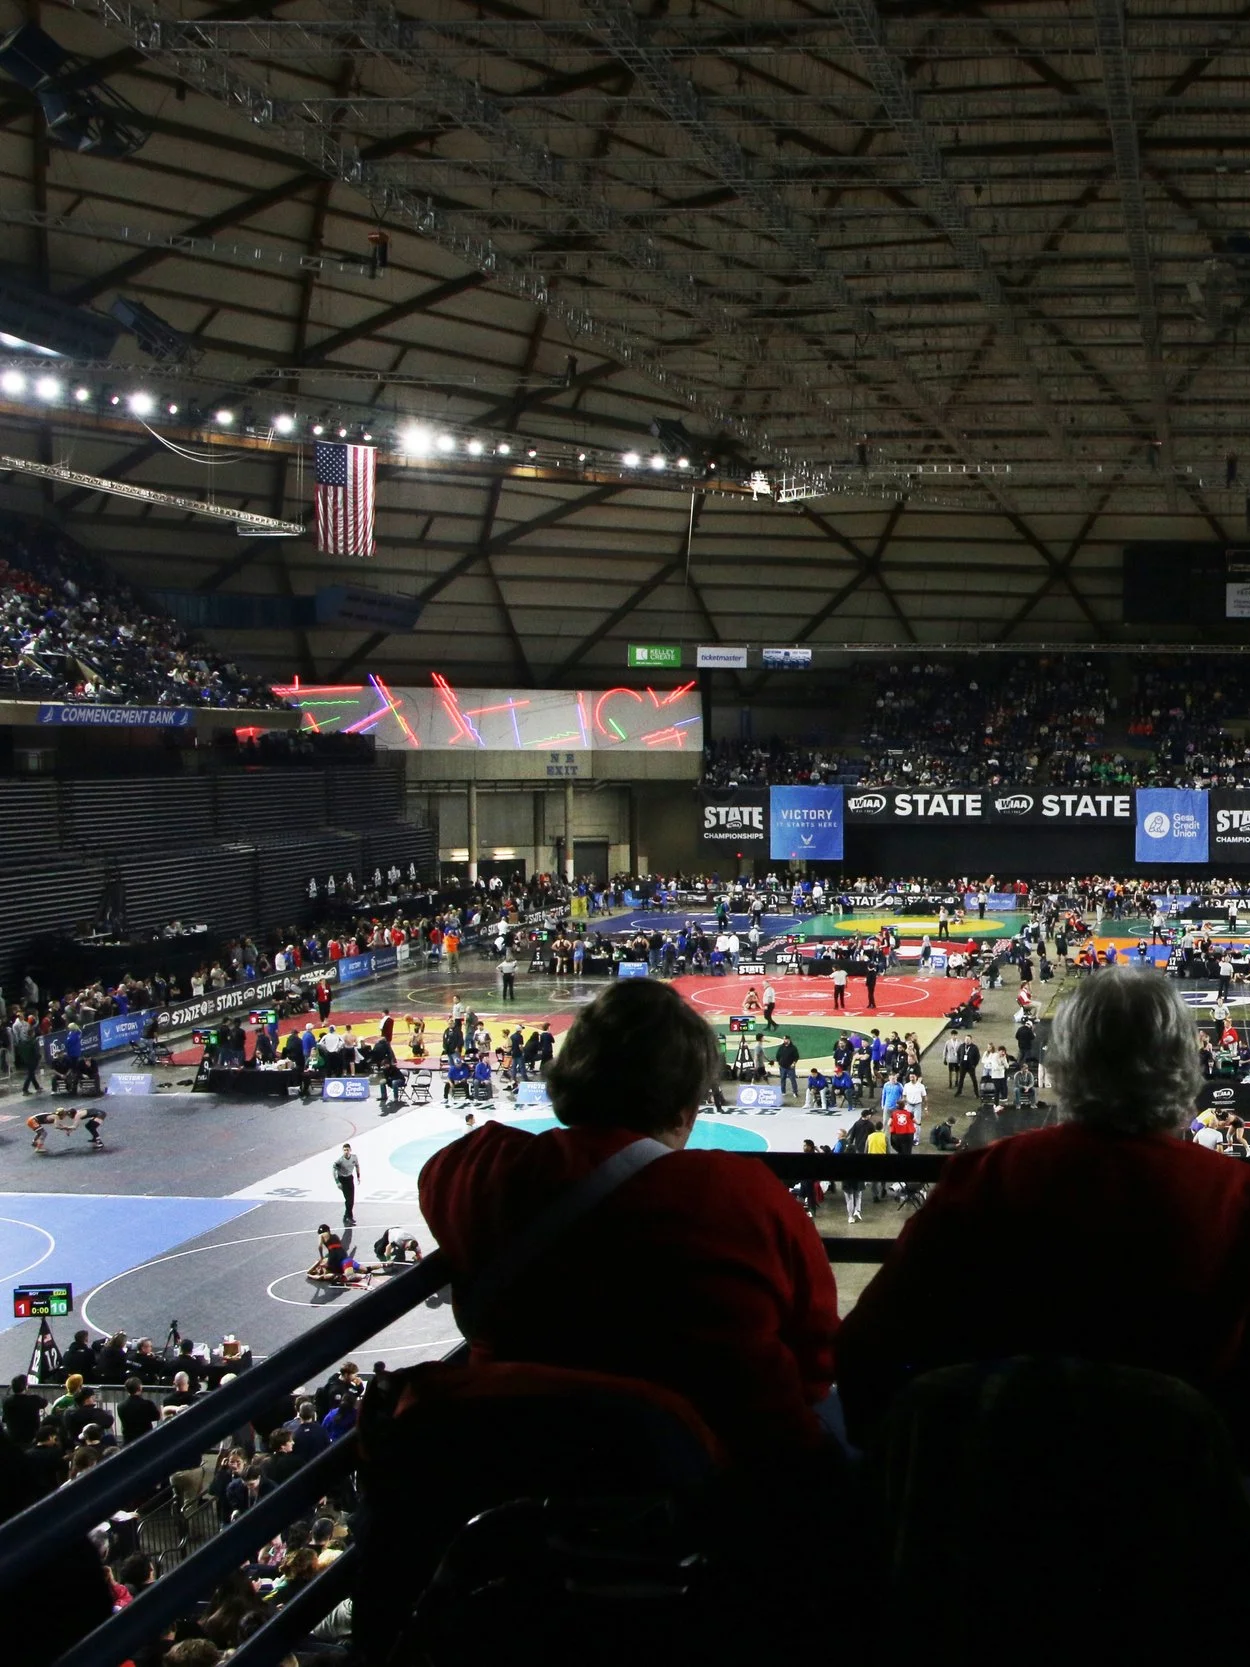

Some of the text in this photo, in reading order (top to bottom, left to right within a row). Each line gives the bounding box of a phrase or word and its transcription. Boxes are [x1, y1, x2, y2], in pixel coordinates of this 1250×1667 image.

[701, 654, 743, 662] ticketmaster
[61, 708, 175, 724] COMMENCEMENT BANK
[547, 765, 578, 776] EXIT
[894, 794, 982, 816] STATE
[1041, 795, 1130, 817] STATE
[704, 806, 763, 829] STATE
[781, 809, 833, 820] VICTORY
[1173, 813, 1194, 822] Gesa
[1173, 821, 1200, 830] Credit
[1173, 829, 1197, 838] Union
[739, 965, 765, 974] STATE
[216, 991, 243, 1011] STATE
[171, 1003, 200, 1025] STATE
[18, 1304, 25, 1315] 1
[51, 1302, 67, 1313] 10
